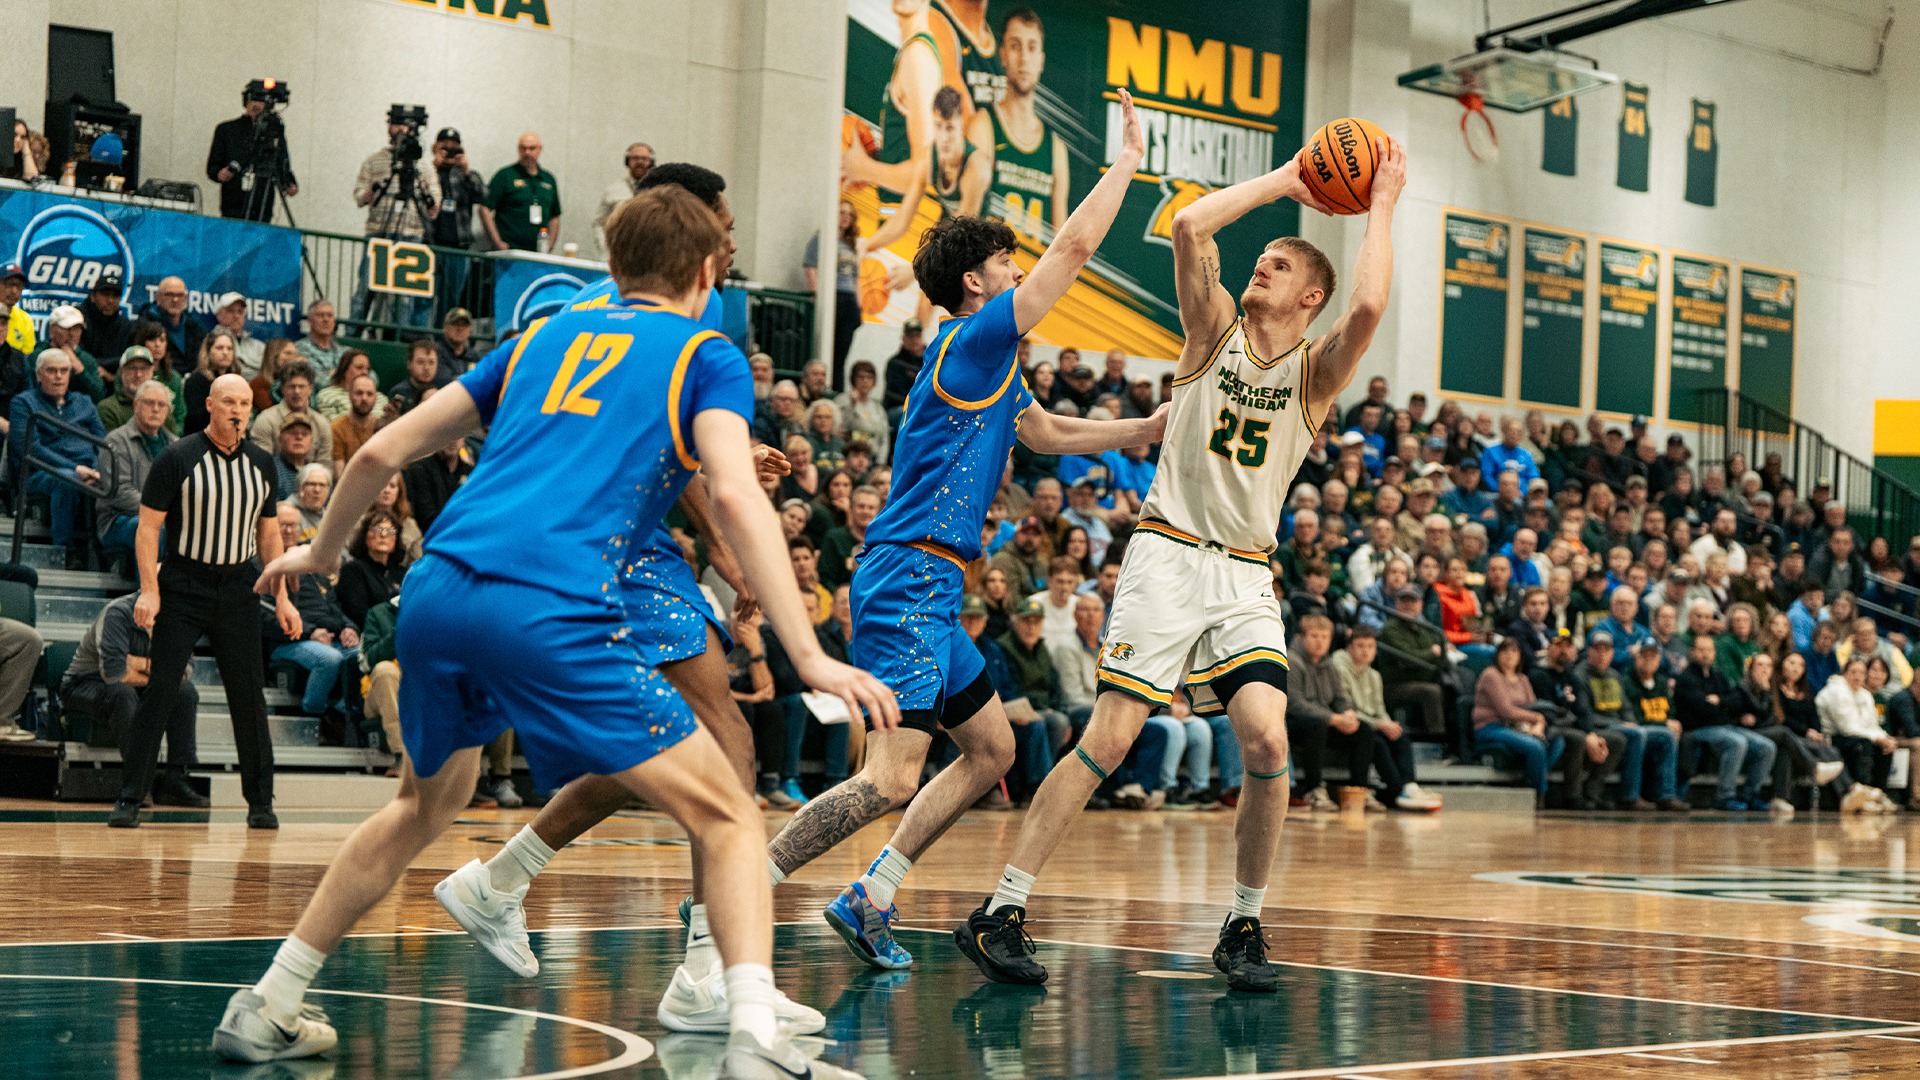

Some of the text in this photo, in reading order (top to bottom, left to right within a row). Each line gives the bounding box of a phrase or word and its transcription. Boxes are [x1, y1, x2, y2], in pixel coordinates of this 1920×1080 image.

[1106, 15, 1282, 117] NMU
[1311, 140, 1333, 184] NCAA
[1333, 121, 1361, 179] Wilson
[370, 240, 433, 295] 12
[541, 332, 634, 417] 12
[1218, 365, 1293, 400] NORTHERN
[1206, 406, 1272, 469] 25
